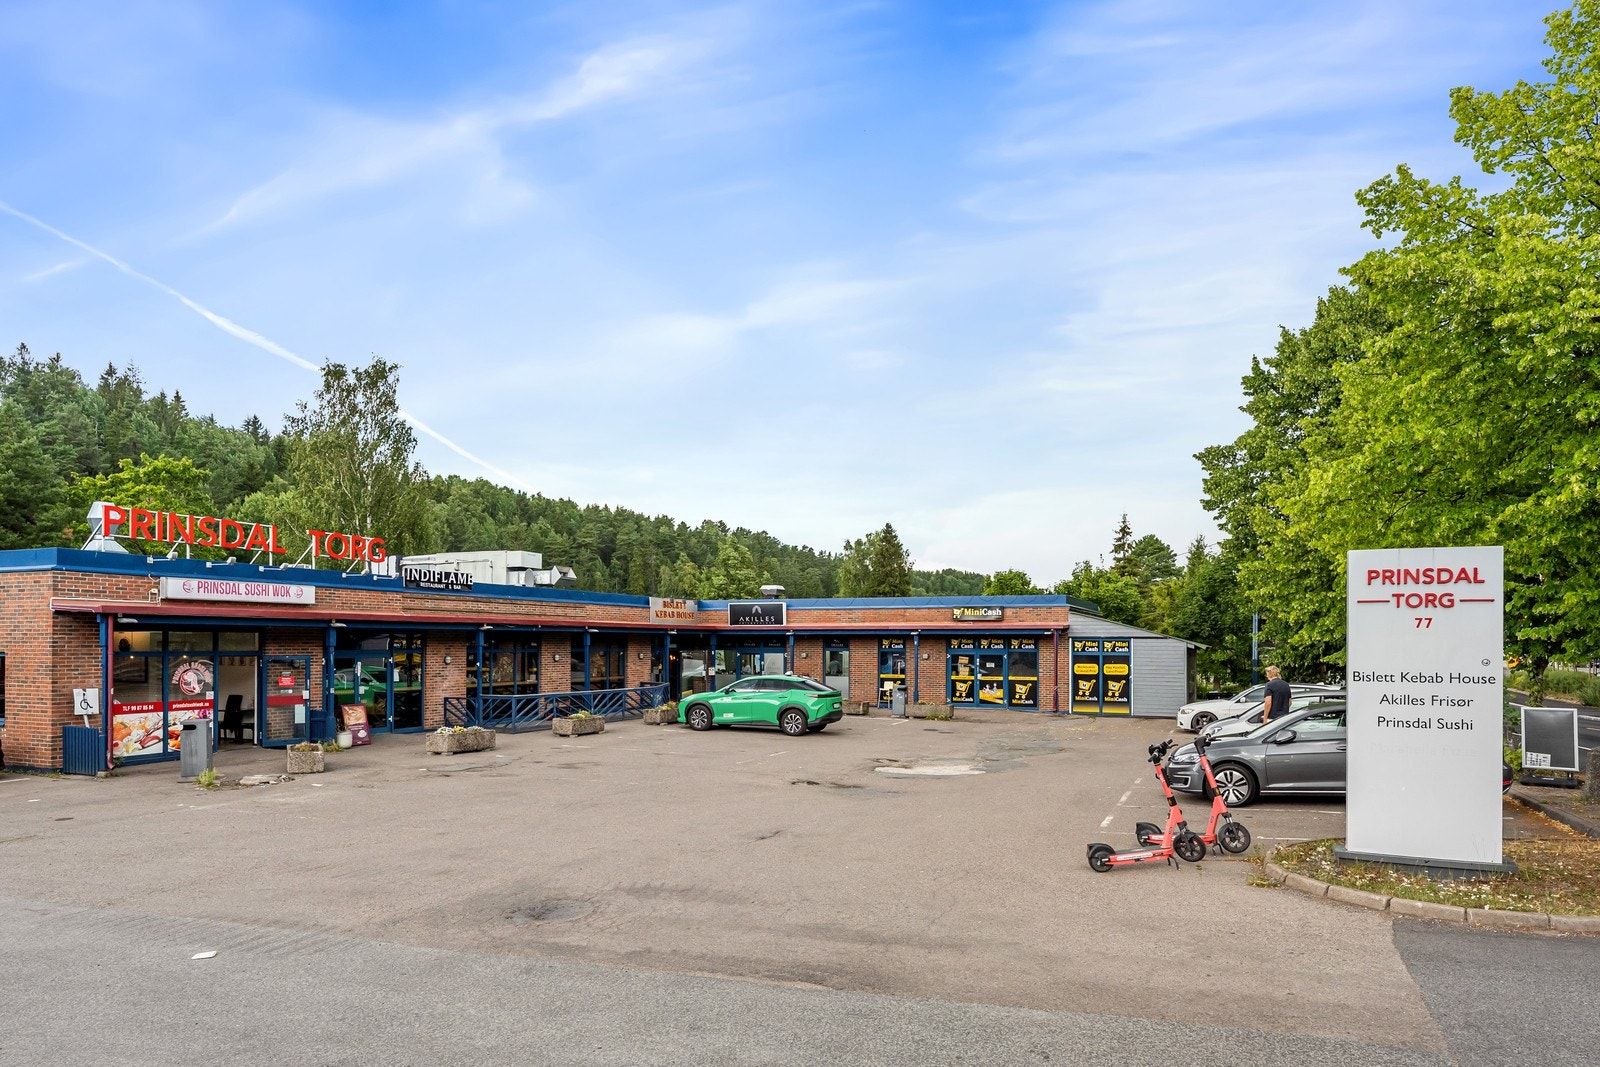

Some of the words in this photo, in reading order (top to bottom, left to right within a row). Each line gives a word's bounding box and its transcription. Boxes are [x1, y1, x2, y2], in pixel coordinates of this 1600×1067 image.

[104, 505, 286, 554] PRINSDAL
[307, 529, 386, 563] TORG
[406, 568, 473, 585] INDIFLAME
[1367, 567, 1485, 585] PRINSDAL
[197, 581, 242, 595] PRINSDAL
[245, 583, 270, 596] SUSHI
[272, 585, 291, 597] WOK
[1391, 592, 1455, 609] TORG
[654, 610, 676, 619] KEBAB
[676, 611, 695, 620] HOUSE
[964, 608, 1002, 616] MiniCash
[1414, 617, 1433, 628] 77
[1352, 671, 1395, 683] Bislett
[1400, 671, 1444, 684] Kebab
[1449, 672, 1496, 685] House
[1379, 694, 1425, 706] Akilles
[1431, 695, 1474, 708] Frisør
[1377, 716, 1432, 730] Prinsdal
[1437, 717, 1474, 731] Sushi
